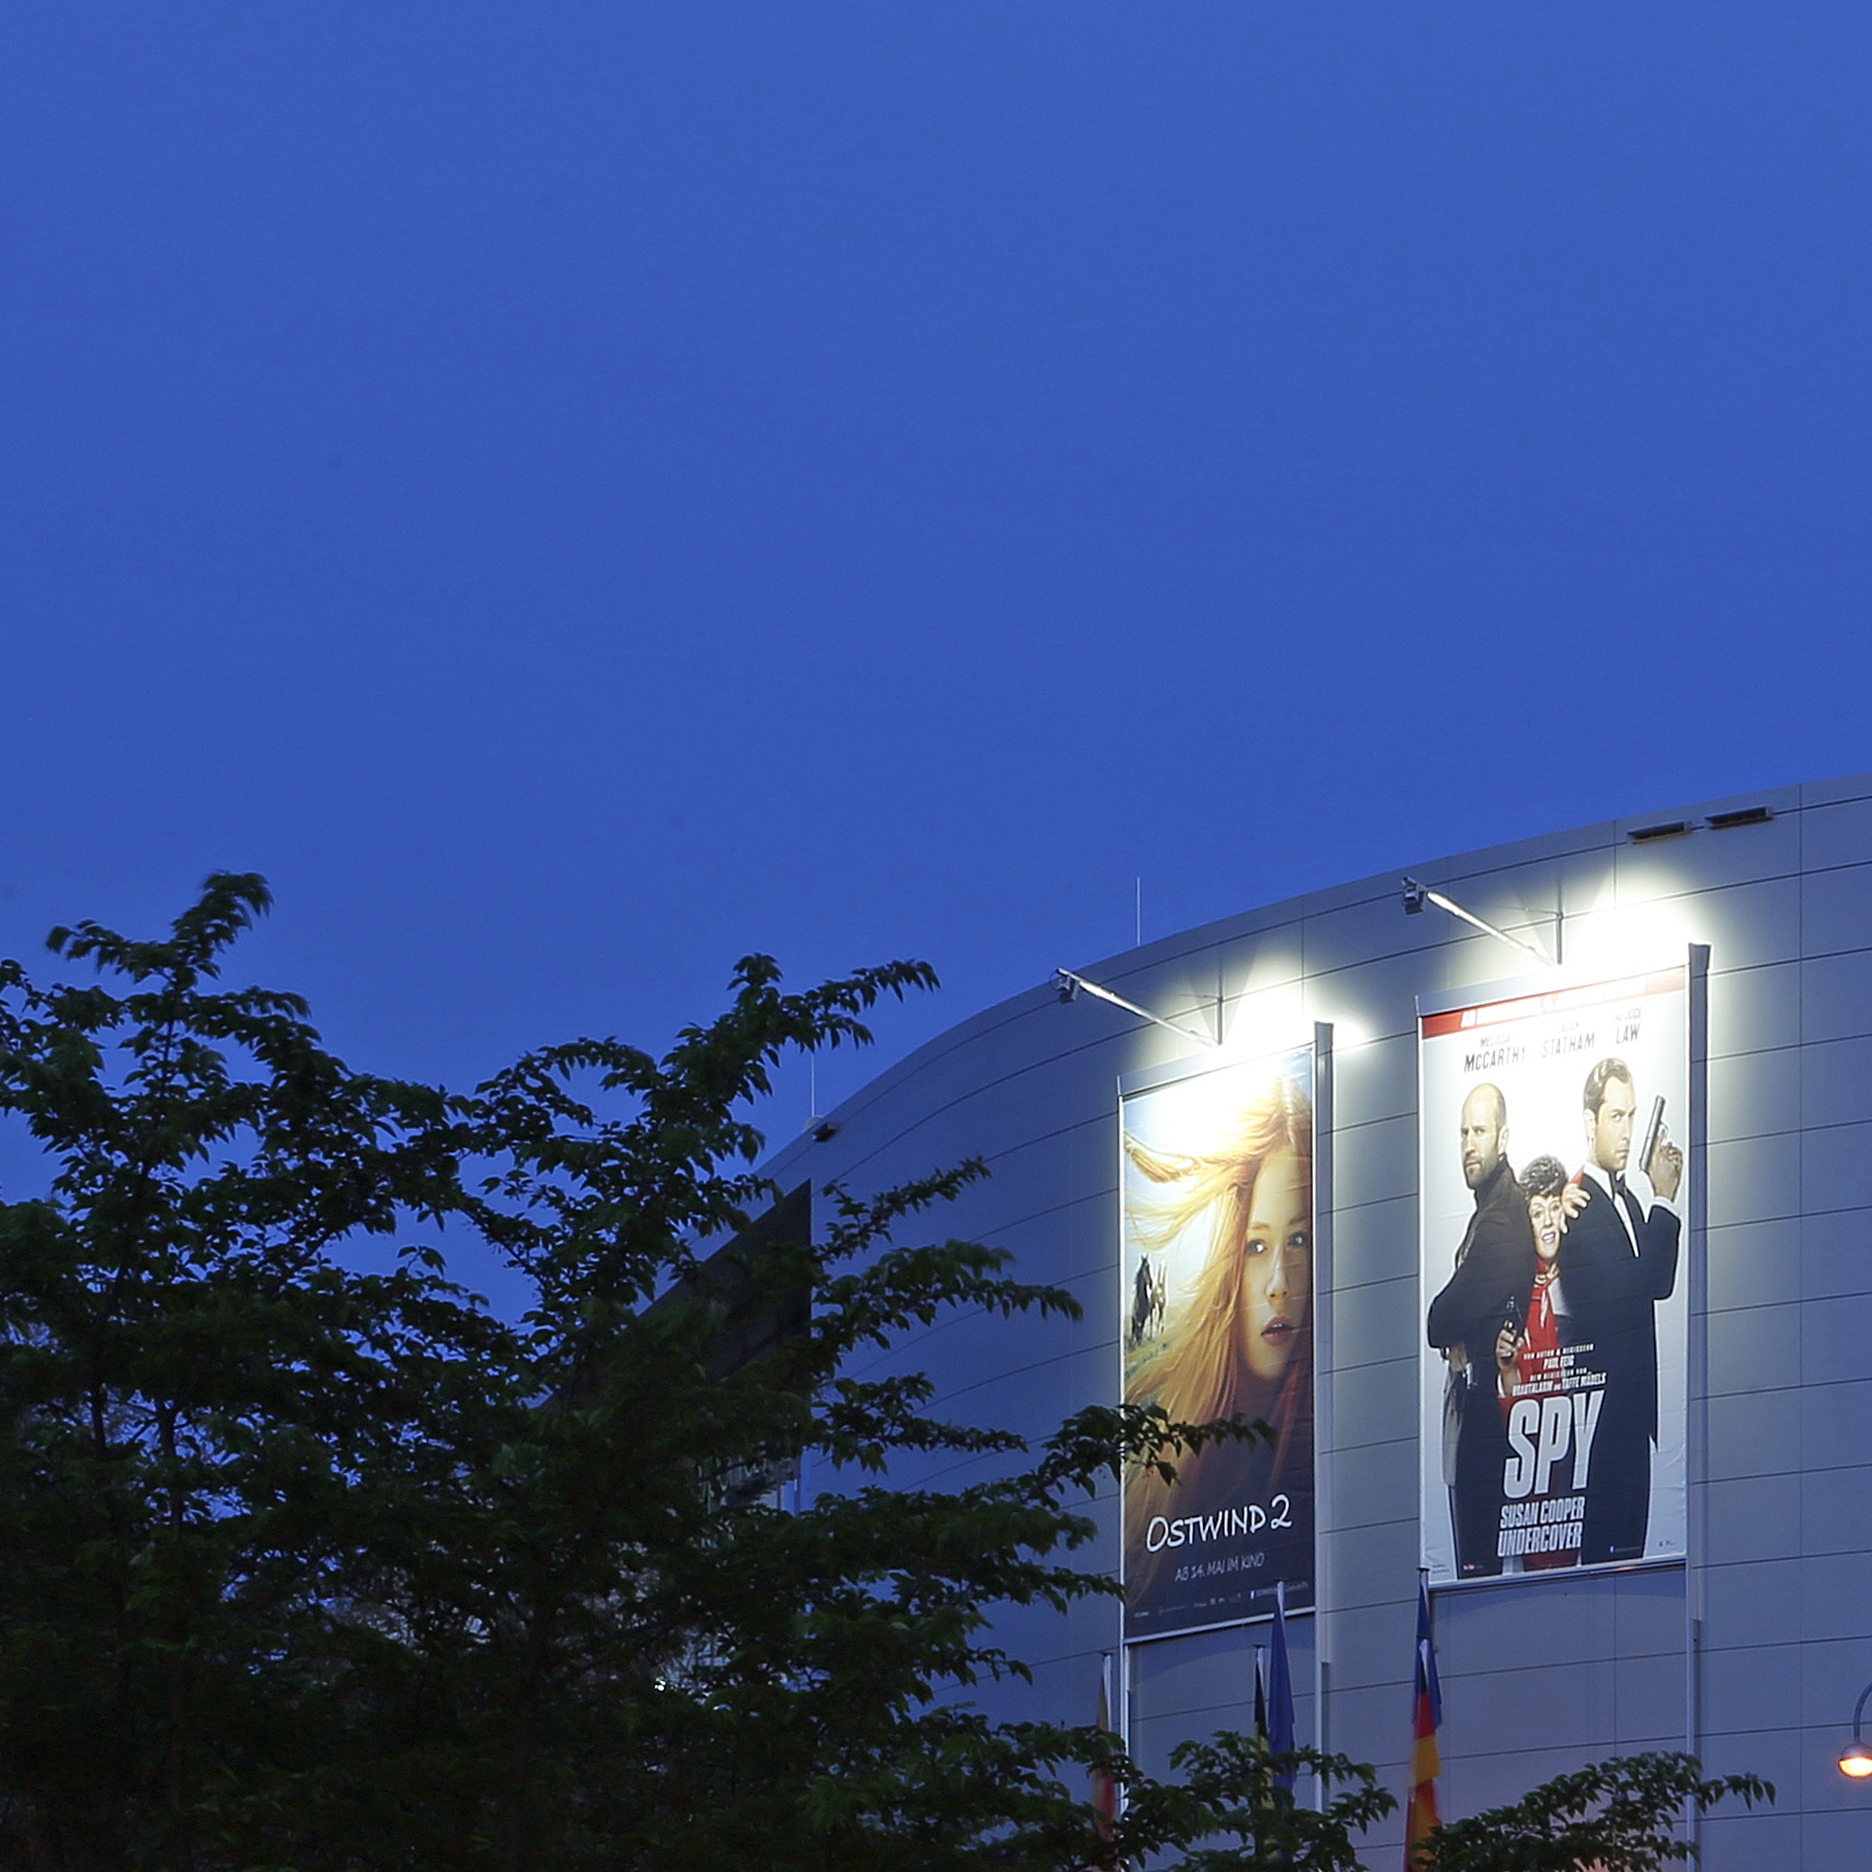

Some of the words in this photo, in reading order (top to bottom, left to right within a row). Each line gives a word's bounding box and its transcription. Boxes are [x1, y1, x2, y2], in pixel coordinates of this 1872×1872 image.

[1542, 1031, 1595, 1058] STATHAM
[1616, 1022, 1641, 1044] LAW
[1503, 1389, 1605, 1499] SPY
[1146, 1504, 1267, 1553] OSTWIND
[1270, 1493, 1293, 1530] 2
[1500, 1501, 1539, 1529] SUSAN
[1539, 1496, 1586, 1524] COOPER
[1497, 1521, 1583, 1558] UNDERCOVER
[1174, 1566, 1190, 1582] AB
[1206, 1559, 1226, 1576] MAI
[1226, 1555, 1239, 1572] IM
[1240, 1551, 1265, 1571] KINO
